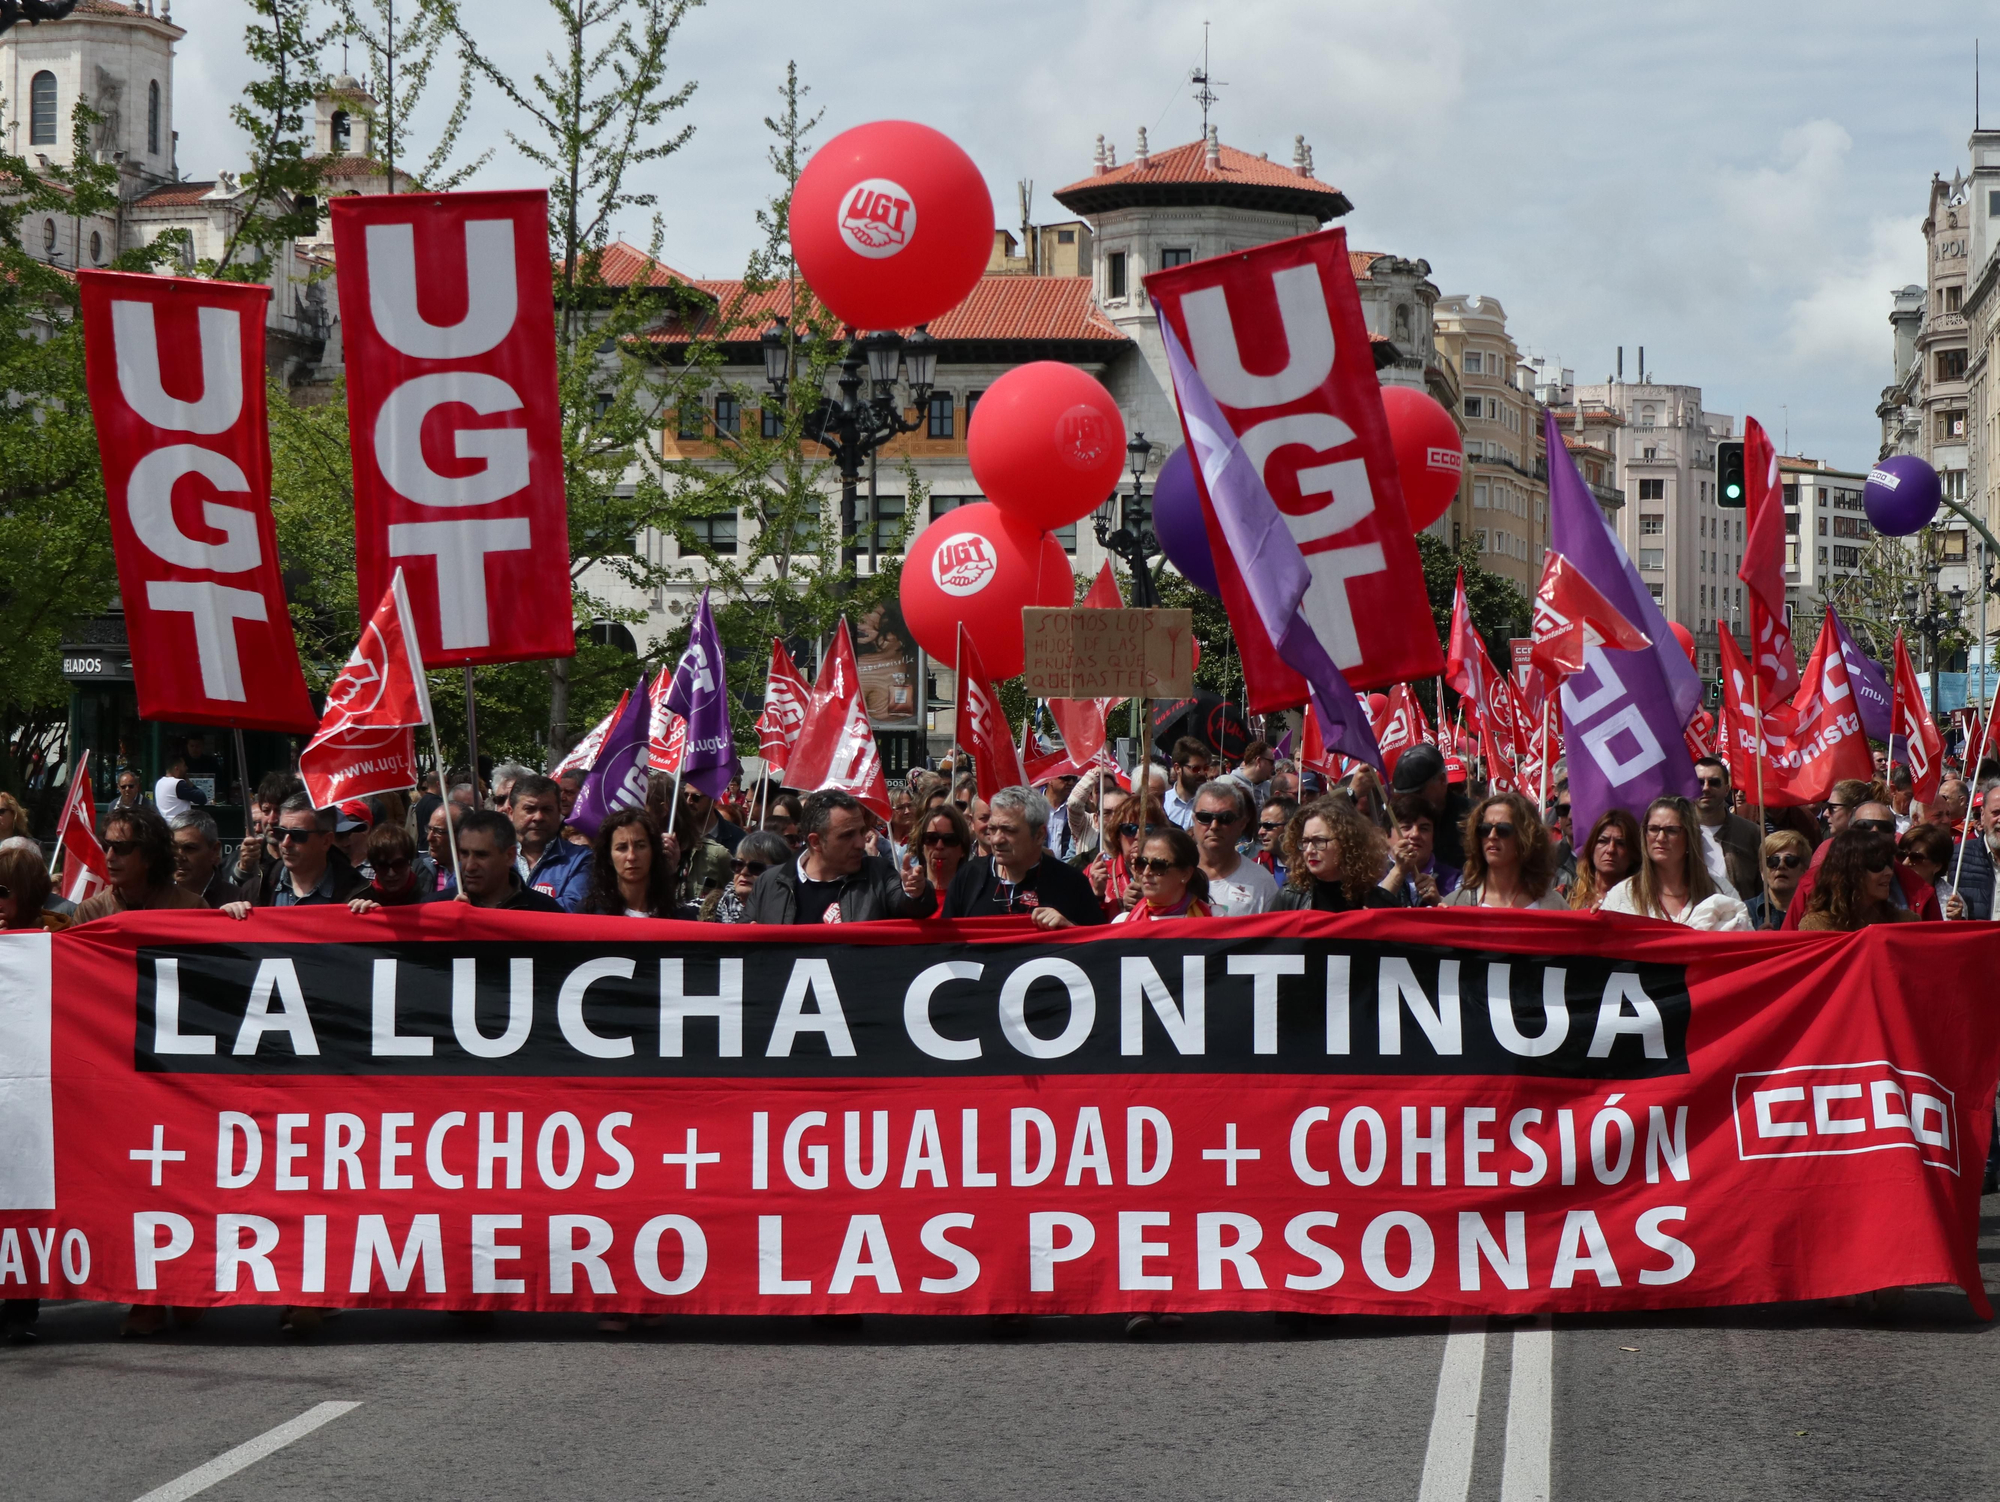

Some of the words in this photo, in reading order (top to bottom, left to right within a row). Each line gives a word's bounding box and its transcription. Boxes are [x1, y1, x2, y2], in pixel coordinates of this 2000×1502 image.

[847, 188, 910, 232] UGT
[364, 219, 531, 650] UGT
[1431, 451, 1460, 467] CCOO
[1179, 263, 1387, 672] UGT
[111, 299, 269, 703] UGT
[939, 537, 984, 576] UGT
[1036, 613, 1107, 634] SOMOS
[1116, 612, 1154, 633] LOS
[1108, 637, 1137, 652] LAS
[1032, 670, 1158, 690] QUEMASTEIS
[1034, 655, 1098, 670] BRUJAS
[1108, 654, 1145, 669] QUE
[154, 957, 320, 1056] LA
[372, 956, 857, 1059] LUCHA
[903, 954, 1669, 1061] CONTINUA
[216, 1111, 635, 1191] DERECHOS
[752, 1105, 1174, 1190] IGUALDAD
[1289, 1093, 1690, 1187] COHESIÓN
[1753, 1079, 1951, 1151] CCOO
[133, 1210, 709, 1295] PRIMERO
[758, 1211, 981, 1295] LAS
[1029, 1205, 1697, 1292] PERSONAS
